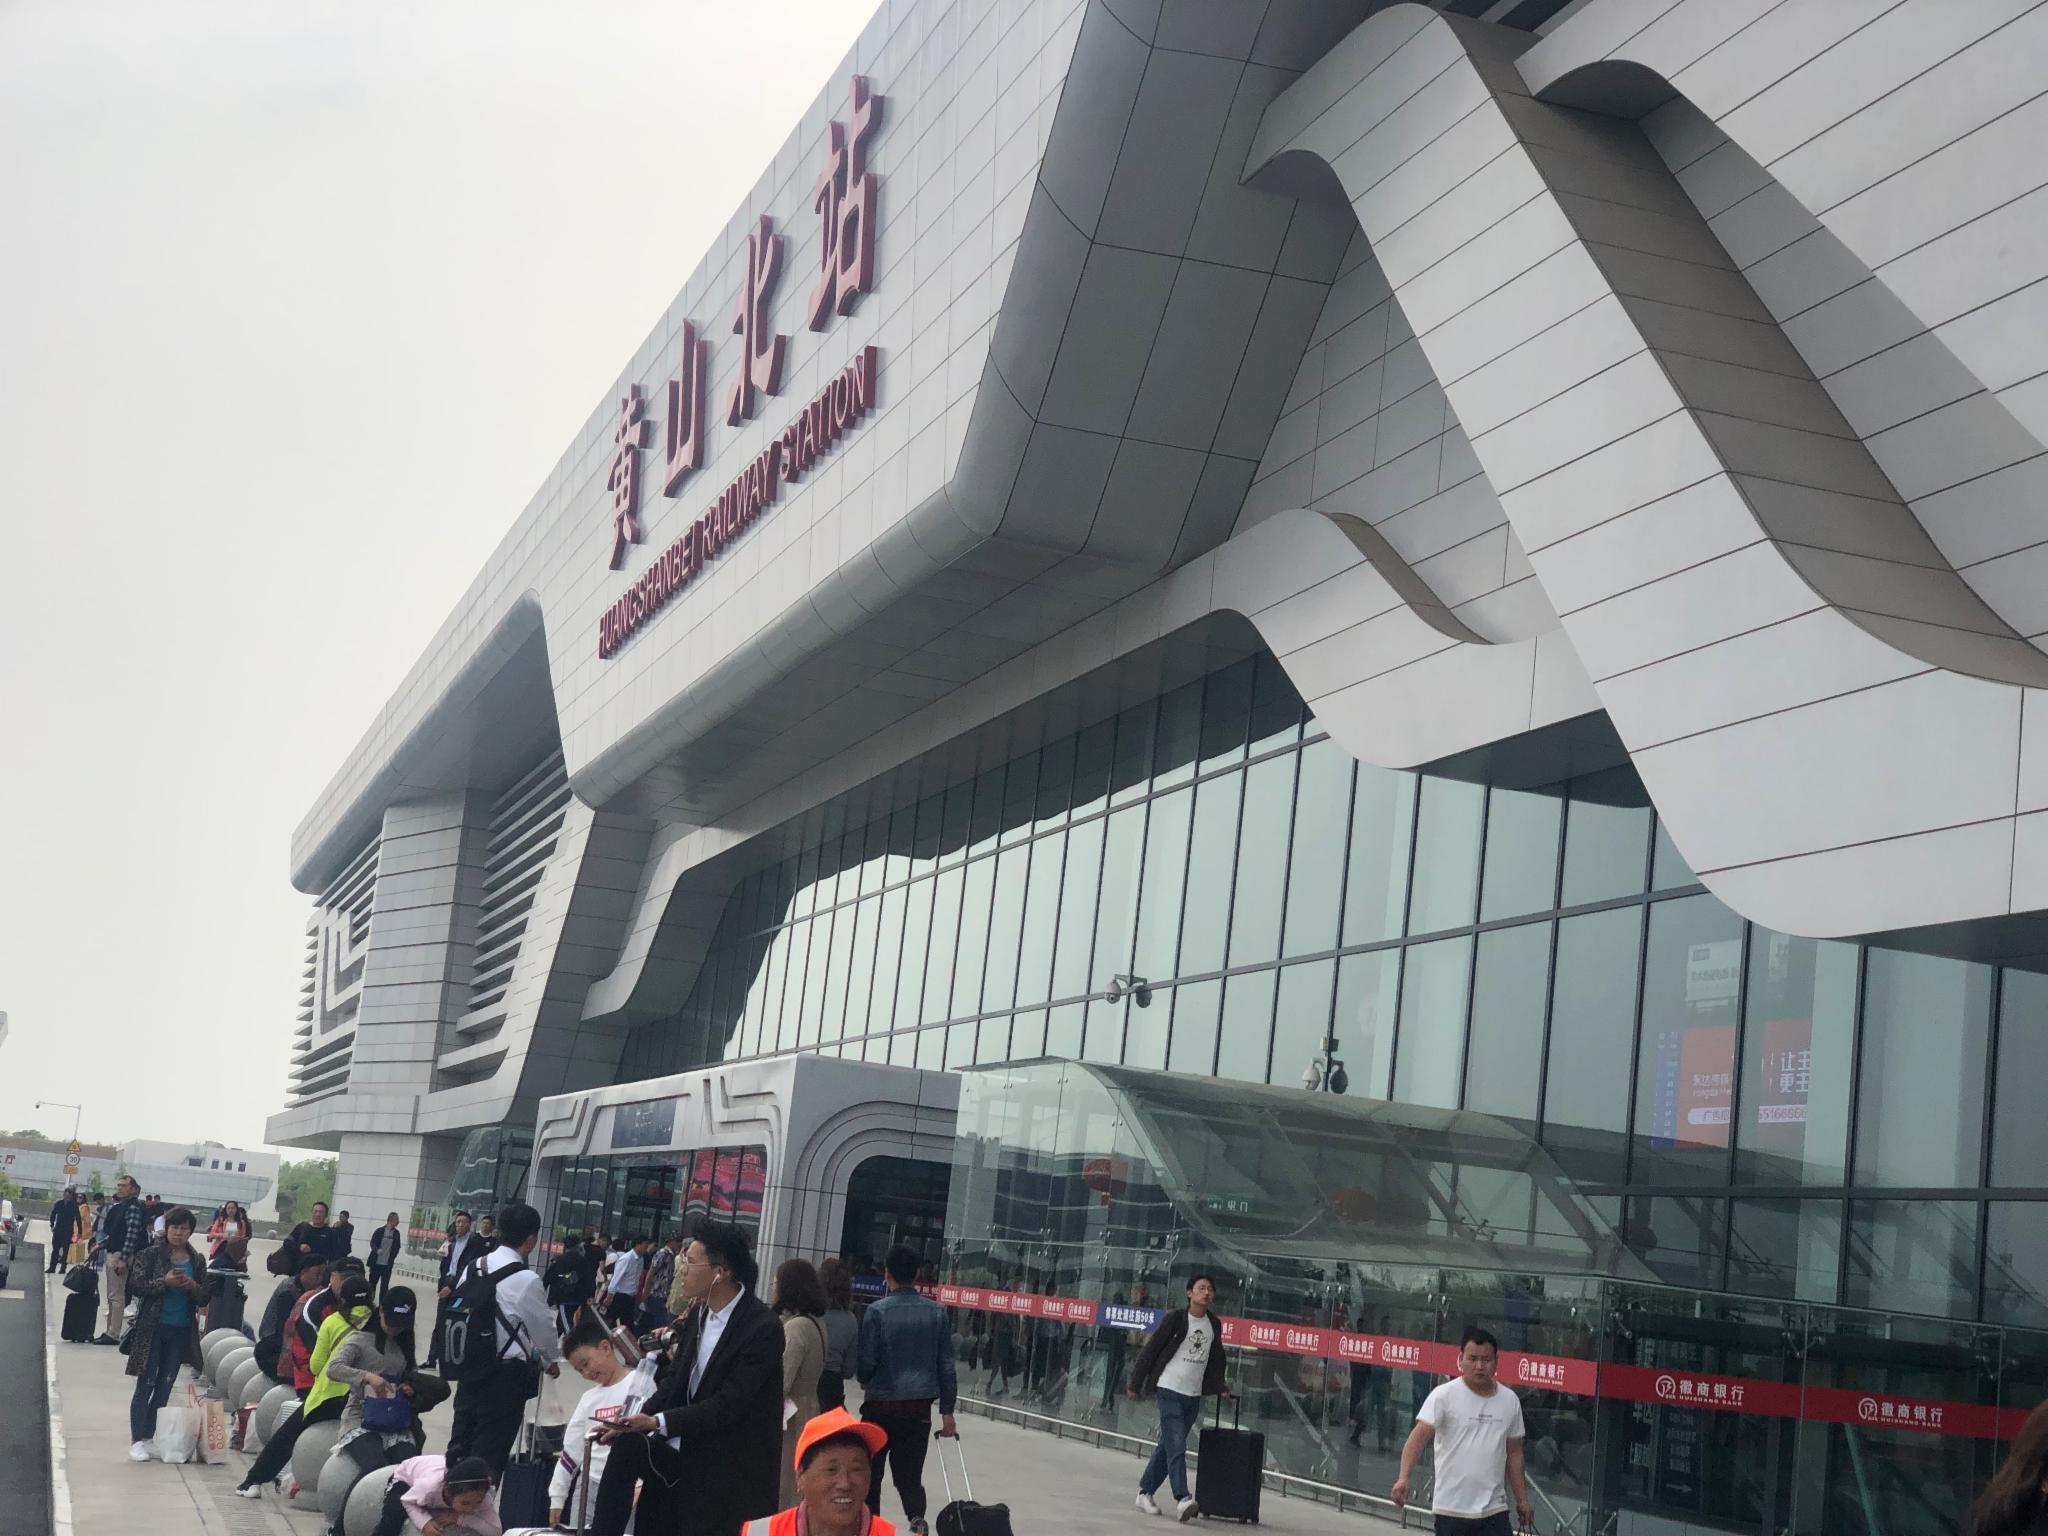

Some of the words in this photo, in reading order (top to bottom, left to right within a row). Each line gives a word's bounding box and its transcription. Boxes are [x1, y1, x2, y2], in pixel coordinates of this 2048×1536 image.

[608, 74, 885, 571] 黄山北站
[599, 520, 704, 659] HUANGSHANBEI
[702, 440, 782, 560] RAILWAY
[780, 346, 877, 483] STATION
[445, 1319, 468, 1365] 10
[1680, 1379, 1744, 1401] 徽商银行
[1881, 1402, 1943, 1423] 徽商银行
